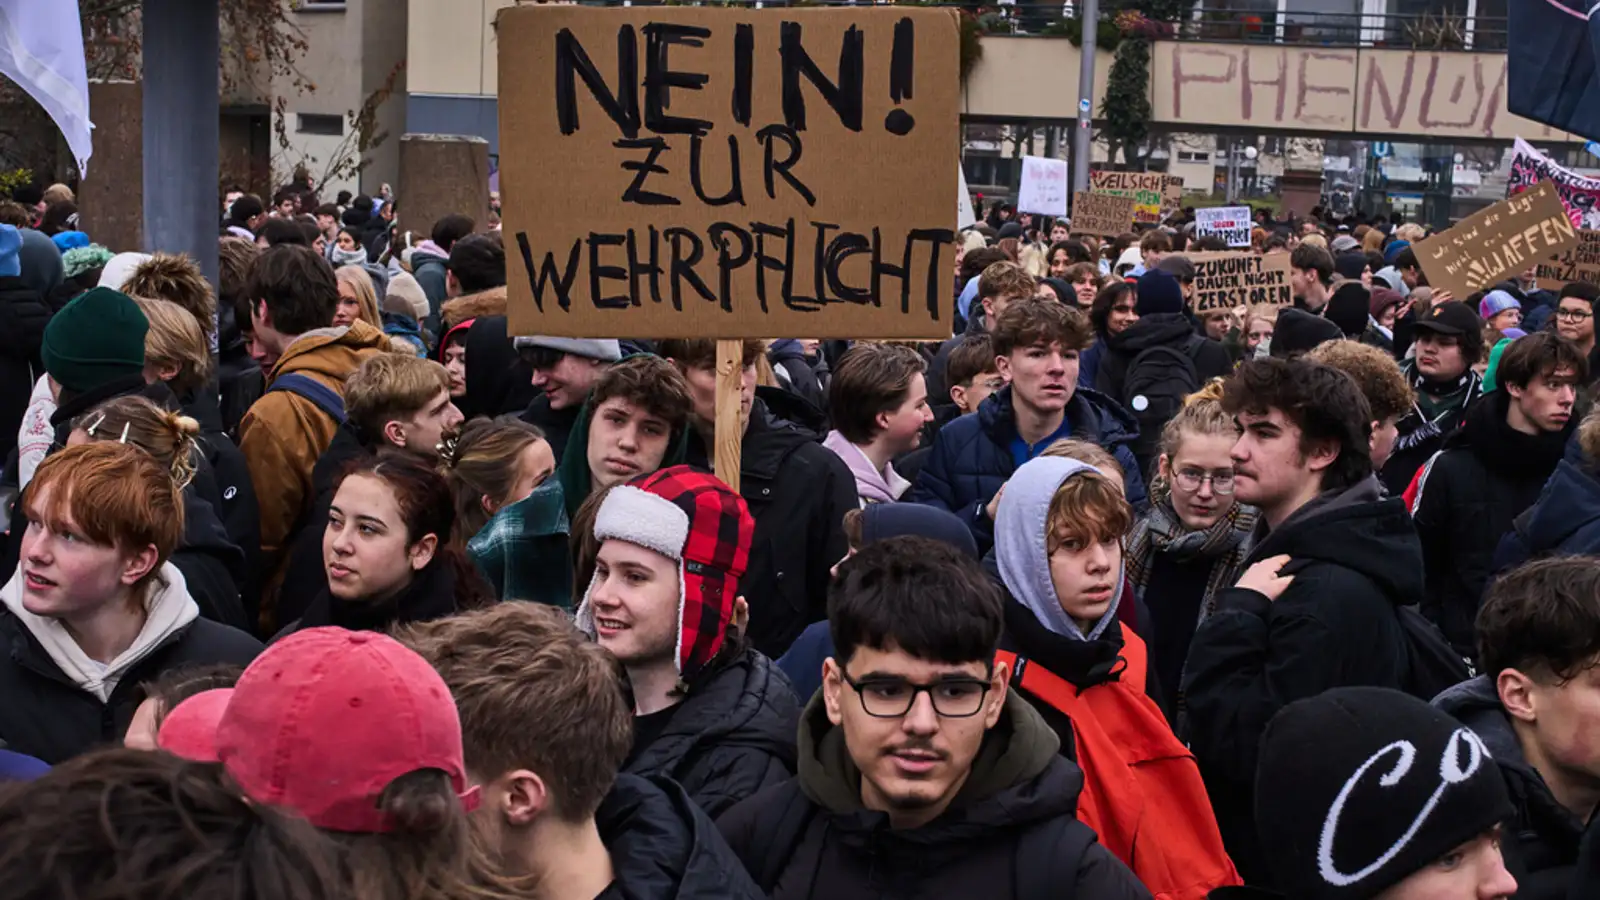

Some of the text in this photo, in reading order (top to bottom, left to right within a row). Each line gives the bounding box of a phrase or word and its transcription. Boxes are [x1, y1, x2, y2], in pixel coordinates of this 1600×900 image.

[555, 17, 915, 138] NEIN!
[613, 124, 816, 206] ZUR
[1131, 174, 1159, 191] SICH
[515, 217, 956, 321] WEHRPFLICHT
[1194, 257, 1262, 277] ZUKUNFT
[1244, 270, 1284, 286] NICHT
